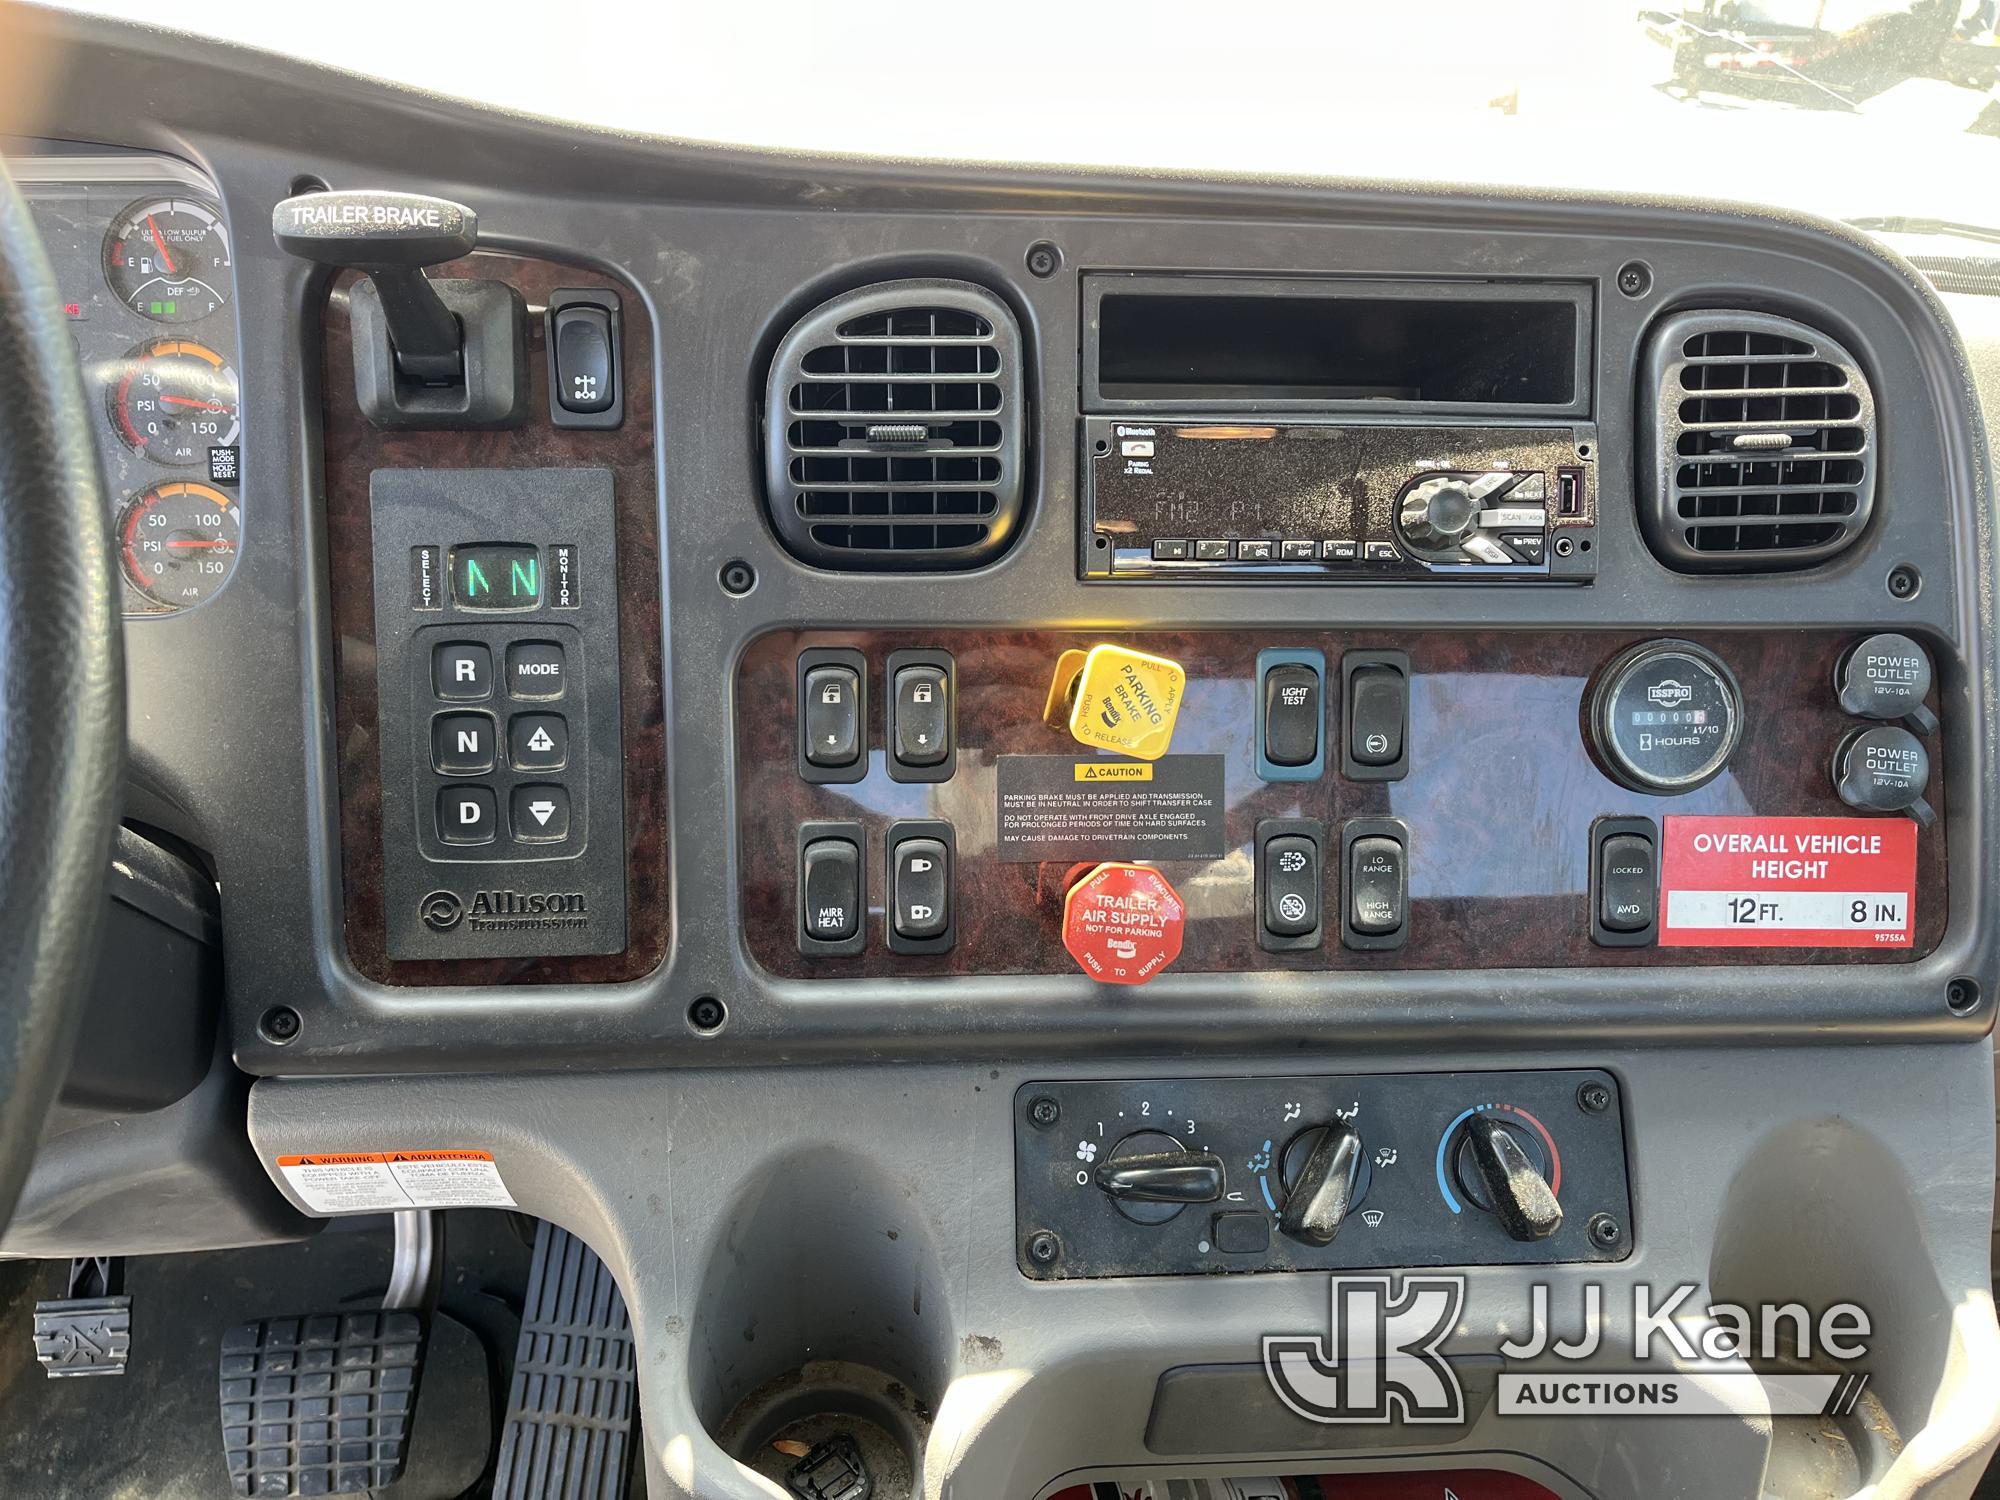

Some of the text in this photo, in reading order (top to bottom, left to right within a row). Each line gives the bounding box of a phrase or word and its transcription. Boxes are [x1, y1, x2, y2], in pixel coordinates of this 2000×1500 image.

[291, 206, 440, 227] TRAILER BRAKE
[128, 257, 135, 267] E
[214, 257, 220, 267] F
[167, 287, 184, 296] DEF
[137, 302, 143, 311] E
[208, 302, 215, 312] F
[142, 374, 160, 386] 50
[137, 400, 155, 411] PSI
[147, 421, 157, 434] 0
[191, 422, 217, 434] 150
[1125, 427, 1156, 436] Bluetooth
[175, 447, 192, 457] AIR
[212, 455, 235, 463] MODE
[213, 470, 236, 478] RESET
[148, 514, 167, 527] 50
[194, 514, 221, 526] 100
[1501, 513, 1521, 521] SCAN
[143, 541, 161, 552] PSI
[1335, 548, 1353, 556] RDM
[1298, 549, 1312, 557] RPT
[154, 562, 163, 574] 0
[198, 562, 223, 574] 150
[421, 549, 431, 607] SELECT
[512, 558, 537, 596] N
[558, 548, 570, 606] MONITOR
[182, 587, 198, 596] AIR
[1867, 656, 1919, 668] POWER
[455, 659, 475, 681] R
[518, 663, 559, 676] MODE
[1866, 667, 1919, 680] OUTLET
[1141, 661, 1178, 714] PULL TO APPLY
[1281, 687, 1308, 696] LIGHT
[1651, 688, 1689, 698] ISSPRO
[1874, 686, 1910, 696] 12V-10A
[1120, 664, 1162, 725] PARKING
[1283, 696, 1305, 705] TEST
[1102, 696, 1121, 723] Bendix
[1114, 684, 1142, 723] BRAKE
[1080, 694, 1133, 747] PUSH TO RELEASE
[1697, 726, 1719, 734] 1/10
[457, 730, 478, 753] N
[1655, 737, 1700, 746] HOURS
[1867, 746, 1918, 761] POWER
[1866, 759, 1918, 773] OUTLET
[1098, 768, 1143, 777] CAUTION
[1873, 777, 1909, 788] 12V-10A
[459, 801, 481, 825] D
[1693, 834, 1882, 855] OVERALL VEHICLE
[1372, 856, 1384, 864] LO
[1363, 865, 1393, 873] RANGE
[1751, 860, 1829, 878] HEIGHT
[1089, 871, 1110, 889] PULL
[1147, 874, 1183, 914] EVACUATE
[467, 890, 588, 914] Allison
[1096, 894, 1159, 912] TRAILER
[1366, 902, 1389, 910] HIGH
[819, 907, 843, 918] MIRR
[1364, 911, 1393, 919] RANGE
[1616, 904, 1640, 915] AWD
[1727, 898, 1901, 923] 12 FT. 8 IN.
[468, 916, 589, 932] Transmission
[818, 917, 844, 928] HEAT
[1082, 909, 1168, 928] AIR SUPPLY
[1085, 924, 1163, 938] NOT FOR PARKING
[1874, 933, 1906, 943] 95755A
[1083, 951, 1167, 977] PUSH TO SUPPLY
[1141, 1101, 1150, 1116] 2
[1097, 1121, 1103, 1137] 1
[1187, 1119, 1195, 1134] 3
[320, 1155, 374, 1164] WARNING
